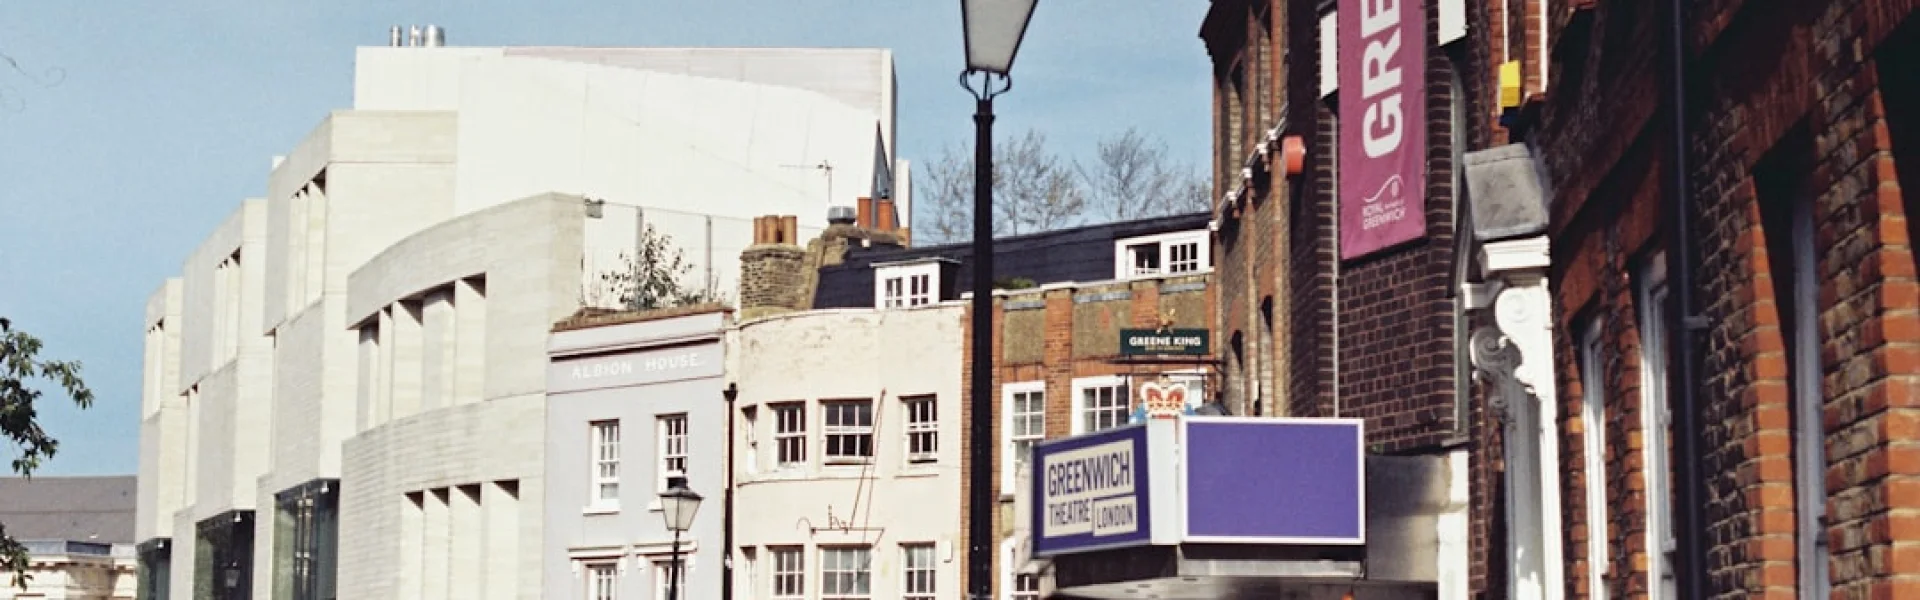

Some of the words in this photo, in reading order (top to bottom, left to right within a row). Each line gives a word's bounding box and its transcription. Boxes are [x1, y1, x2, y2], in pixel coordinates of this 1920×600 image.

[1128, 336, 1171, 346] GREENE
[1173, 336, 1201, 346] KING
[572, 361, 632, 380] ALBION
[1049, 451, 1130, 497] GREENWICH
[1049, 499, 1090, 527] THEATRE
[1097, 504, 1133, 529] LONDON
